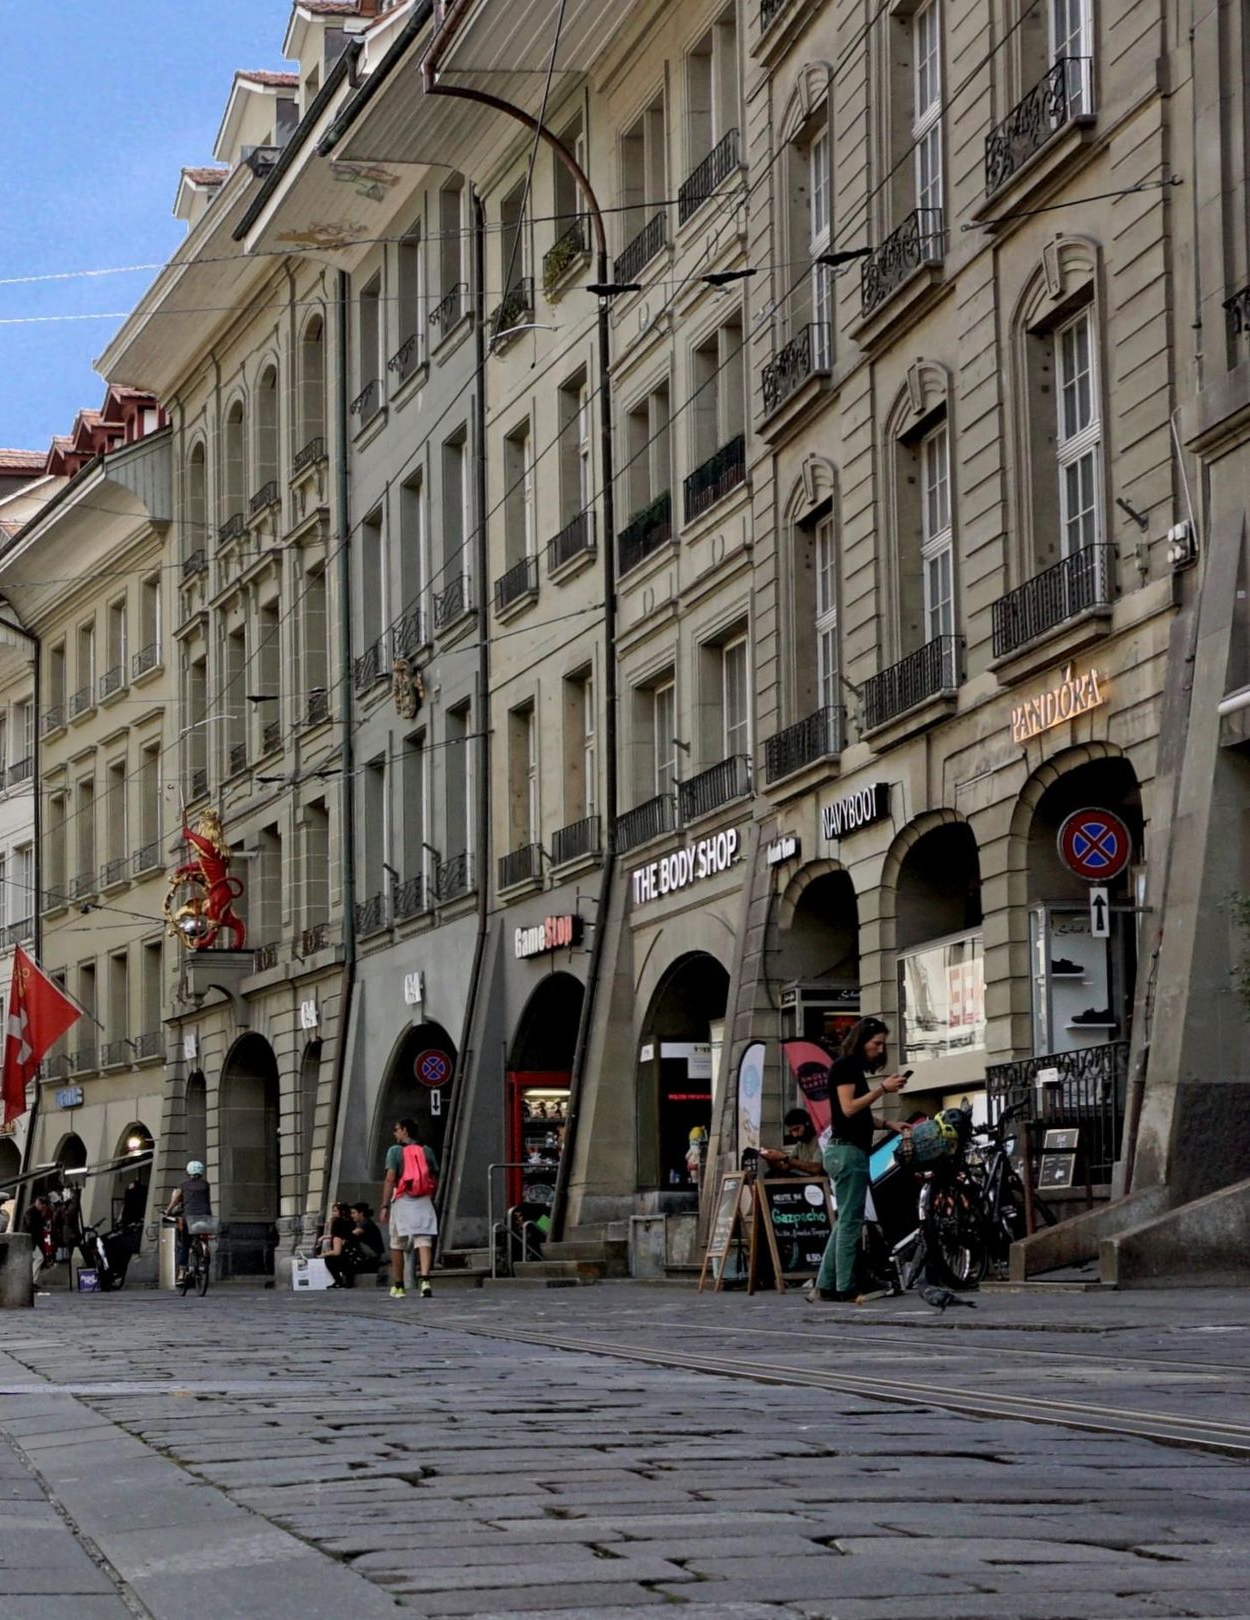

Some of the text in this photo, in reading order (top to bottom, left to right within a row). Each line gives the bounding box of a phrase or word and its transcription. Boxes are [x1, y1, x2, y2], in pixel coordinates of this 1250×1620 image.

[822, 783, 877, 840] NAVYBOOT
[633, 868, 659, 904] THE
[659, 844, 697, 894] BODY
[697, 828, 738, 878] SHOP
[515, 915, 572, 959] GameStop
[772, 1207, 826, 1229] Gazpacho
